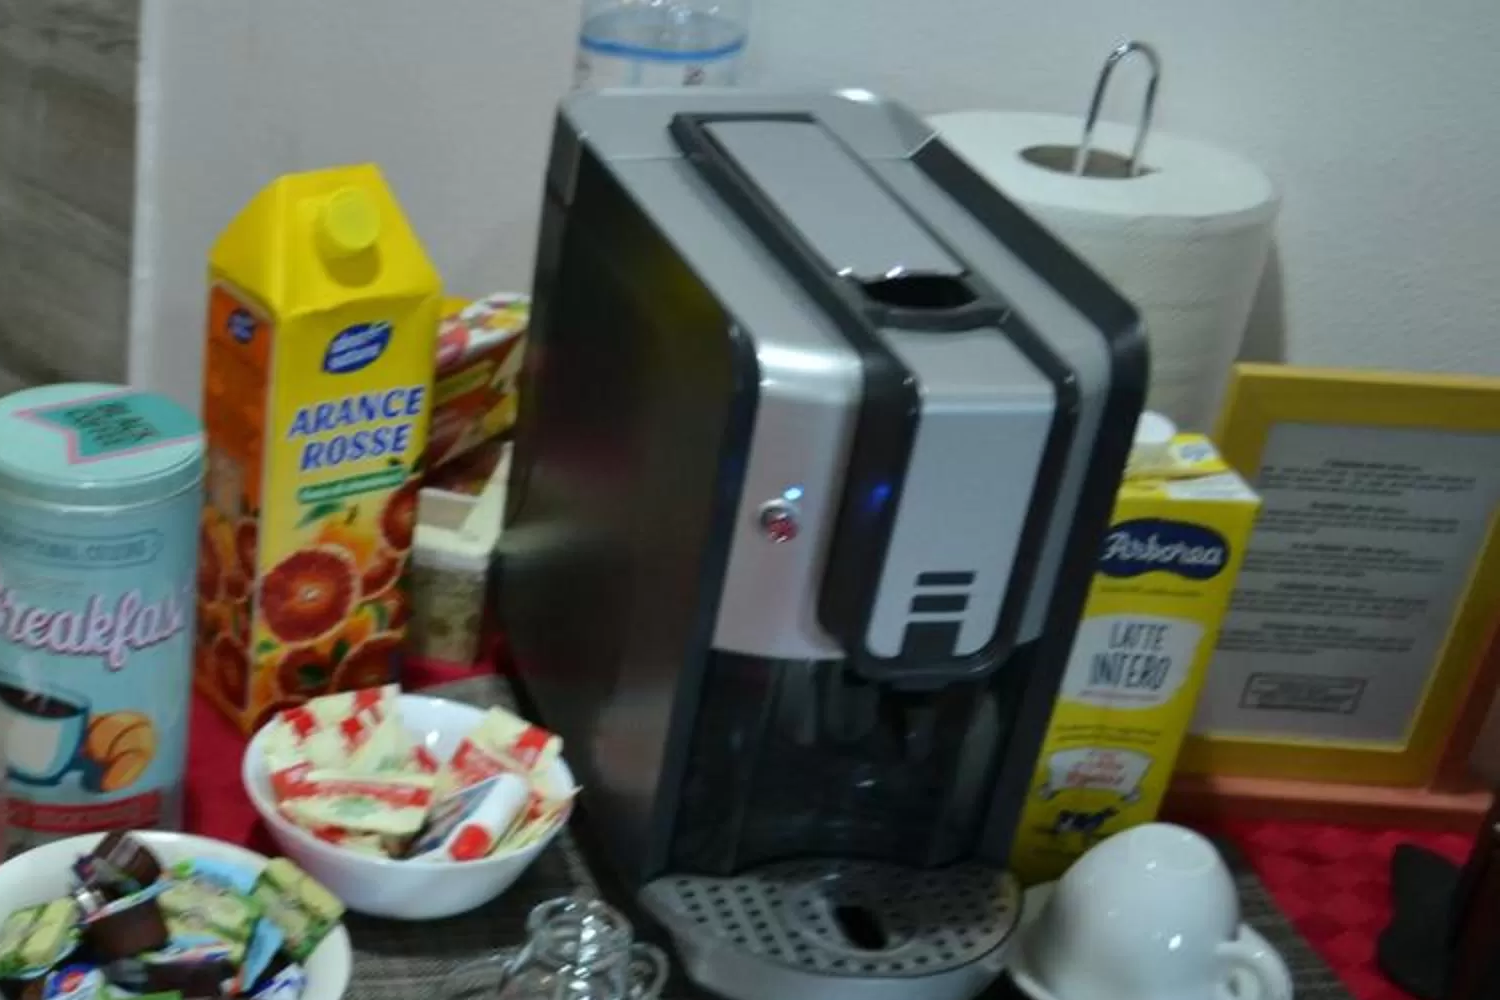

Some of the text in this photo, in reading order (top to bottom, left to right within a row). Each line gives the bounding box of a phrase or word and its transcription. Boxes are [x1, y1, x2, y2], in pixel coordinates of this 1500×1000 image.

[287, 385, 425, 440] ARANCE
[299, 422, 413, 471] ROSSE
[1108, 619, 1169, 651] LATTE
[1087, 651, 1173, 691] INTERO
